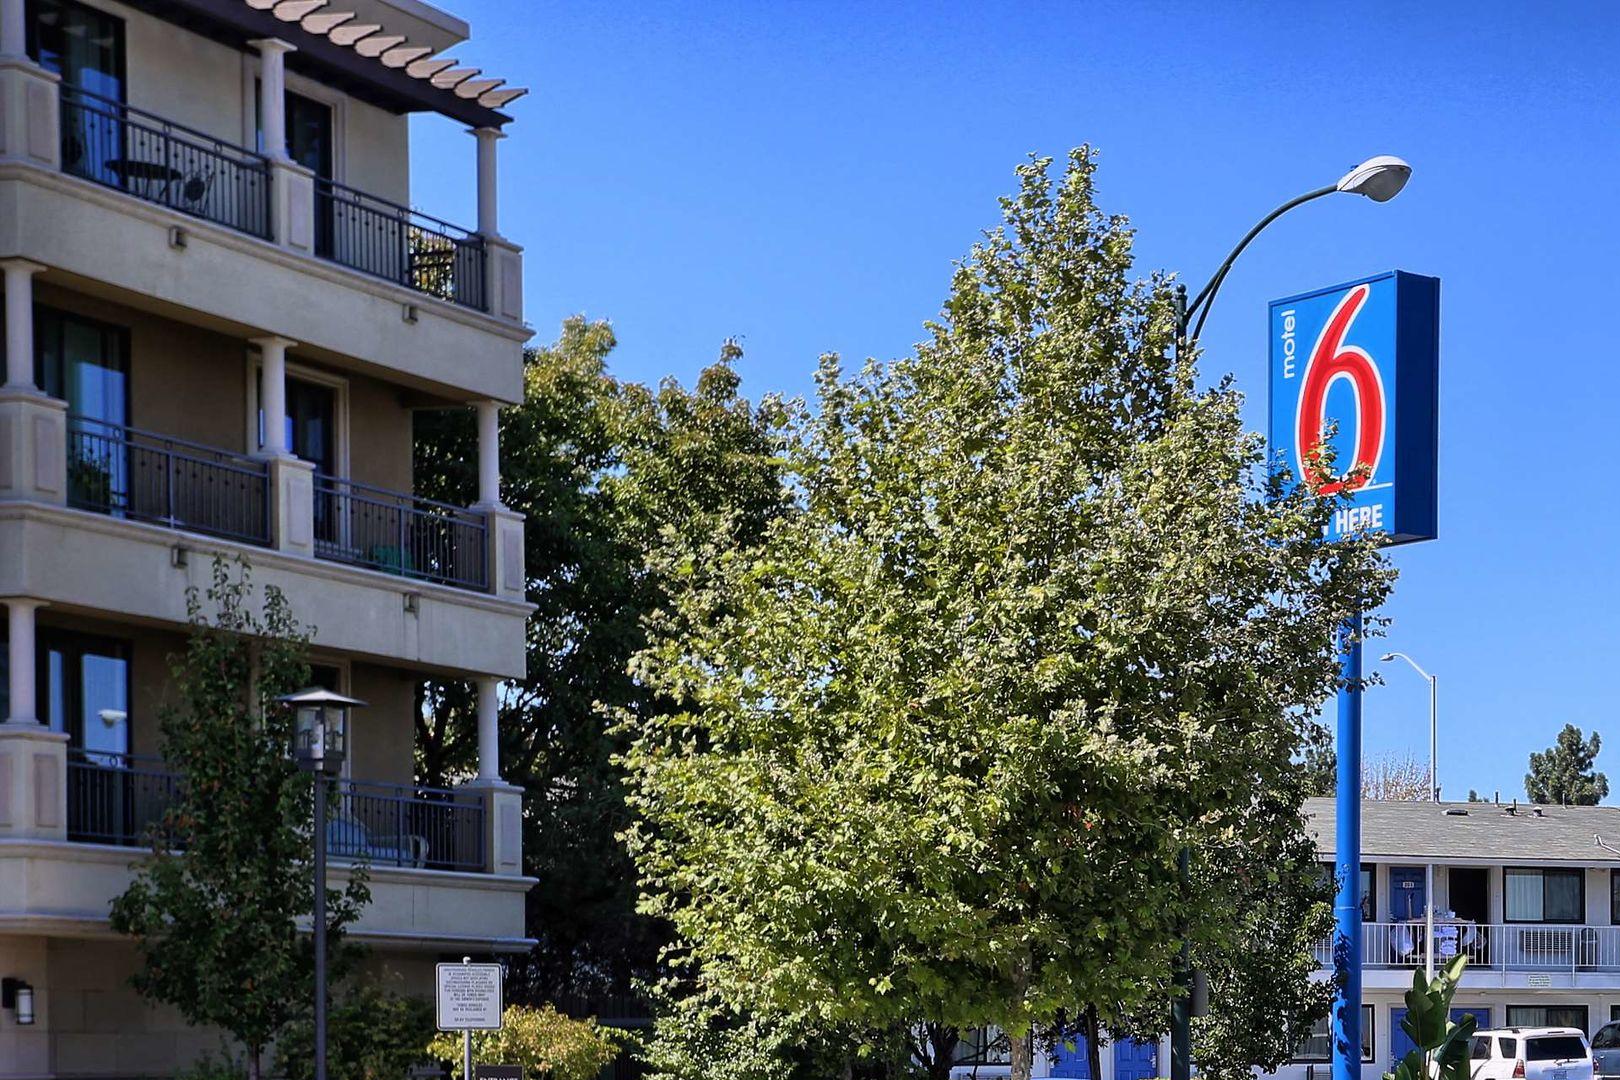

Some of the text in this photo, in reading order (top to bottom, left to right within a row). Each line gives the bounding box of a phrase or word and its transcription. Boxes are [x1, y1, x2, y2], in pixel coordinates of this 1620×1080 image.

[1281, 309, 1296, 378] motel
[1295, 284, 1386, 495] 6
[1335, 503, 1383, 534] HERE
